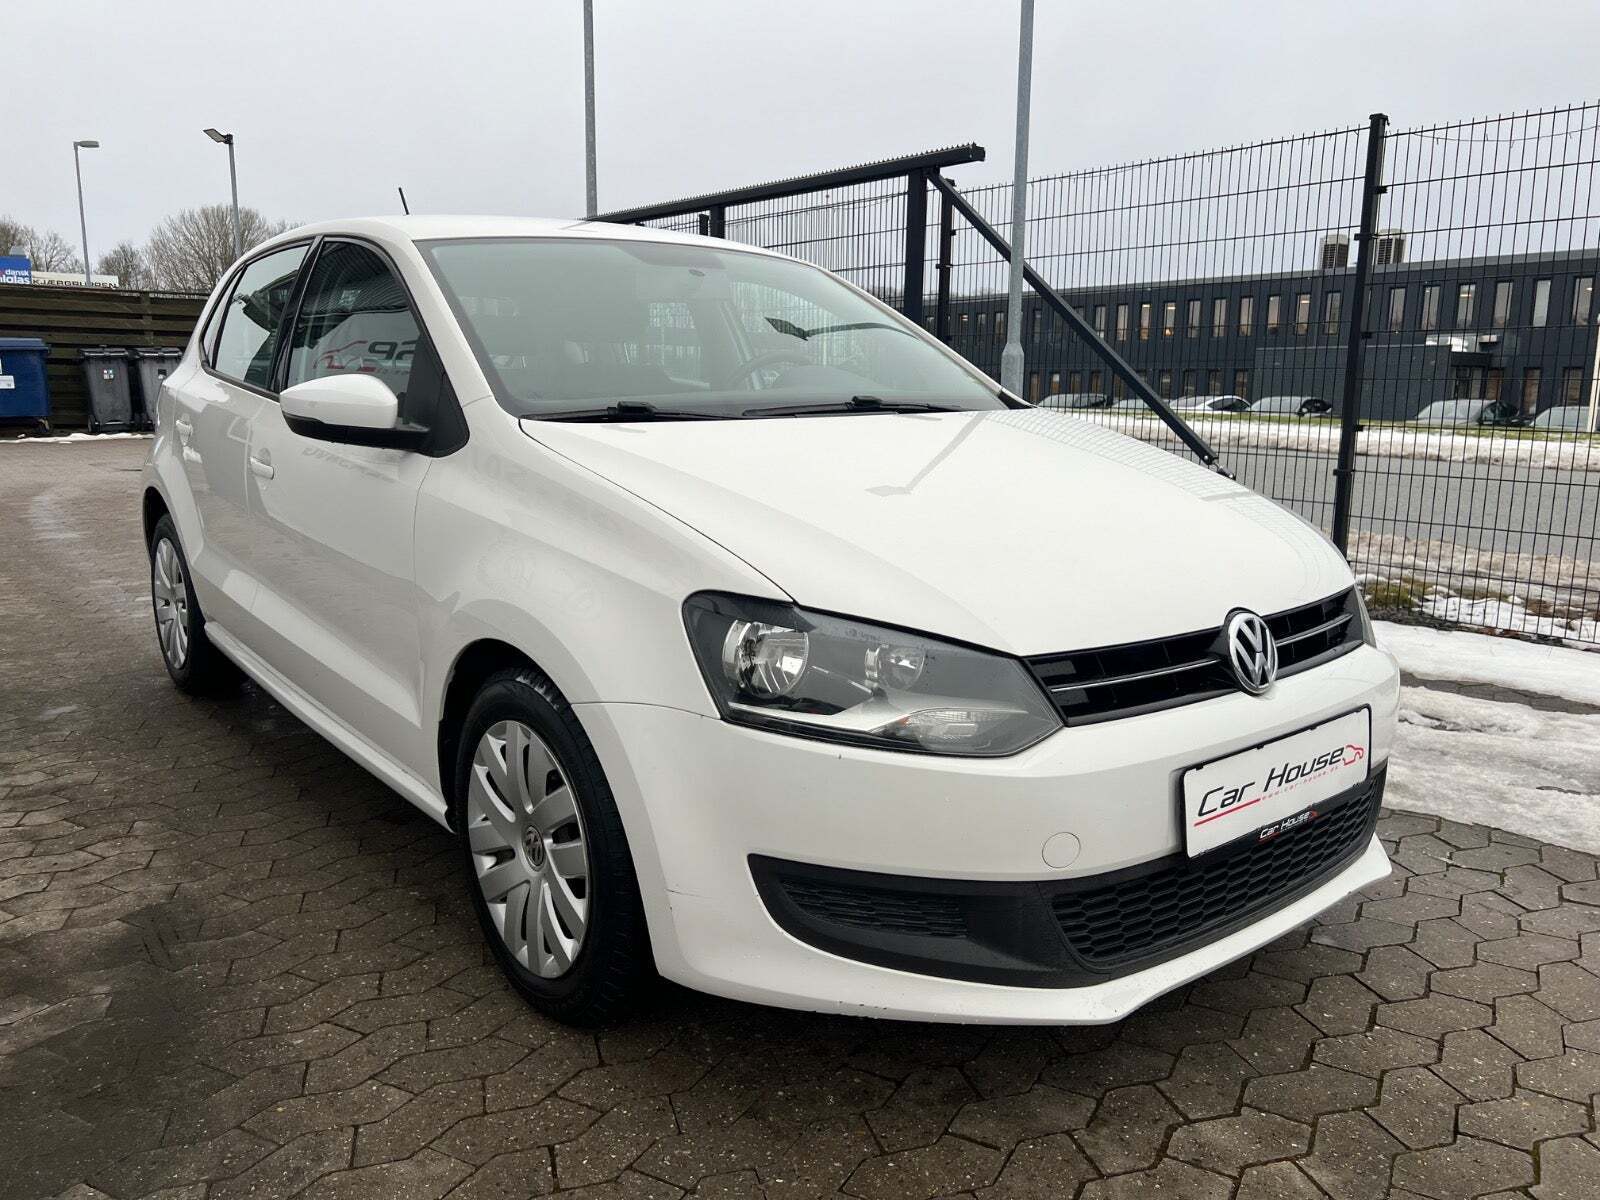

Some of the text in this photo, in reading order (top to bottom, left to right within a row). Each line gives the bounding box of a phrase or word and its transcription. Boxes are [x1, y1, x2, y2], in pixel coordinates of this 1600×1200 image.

[5, 268, 29, 276] dansk
[1231, 615, 1275, 690] VW
[1198, 746, 1345, 817] Car House
[1260, 825, 1280, 839] Car
